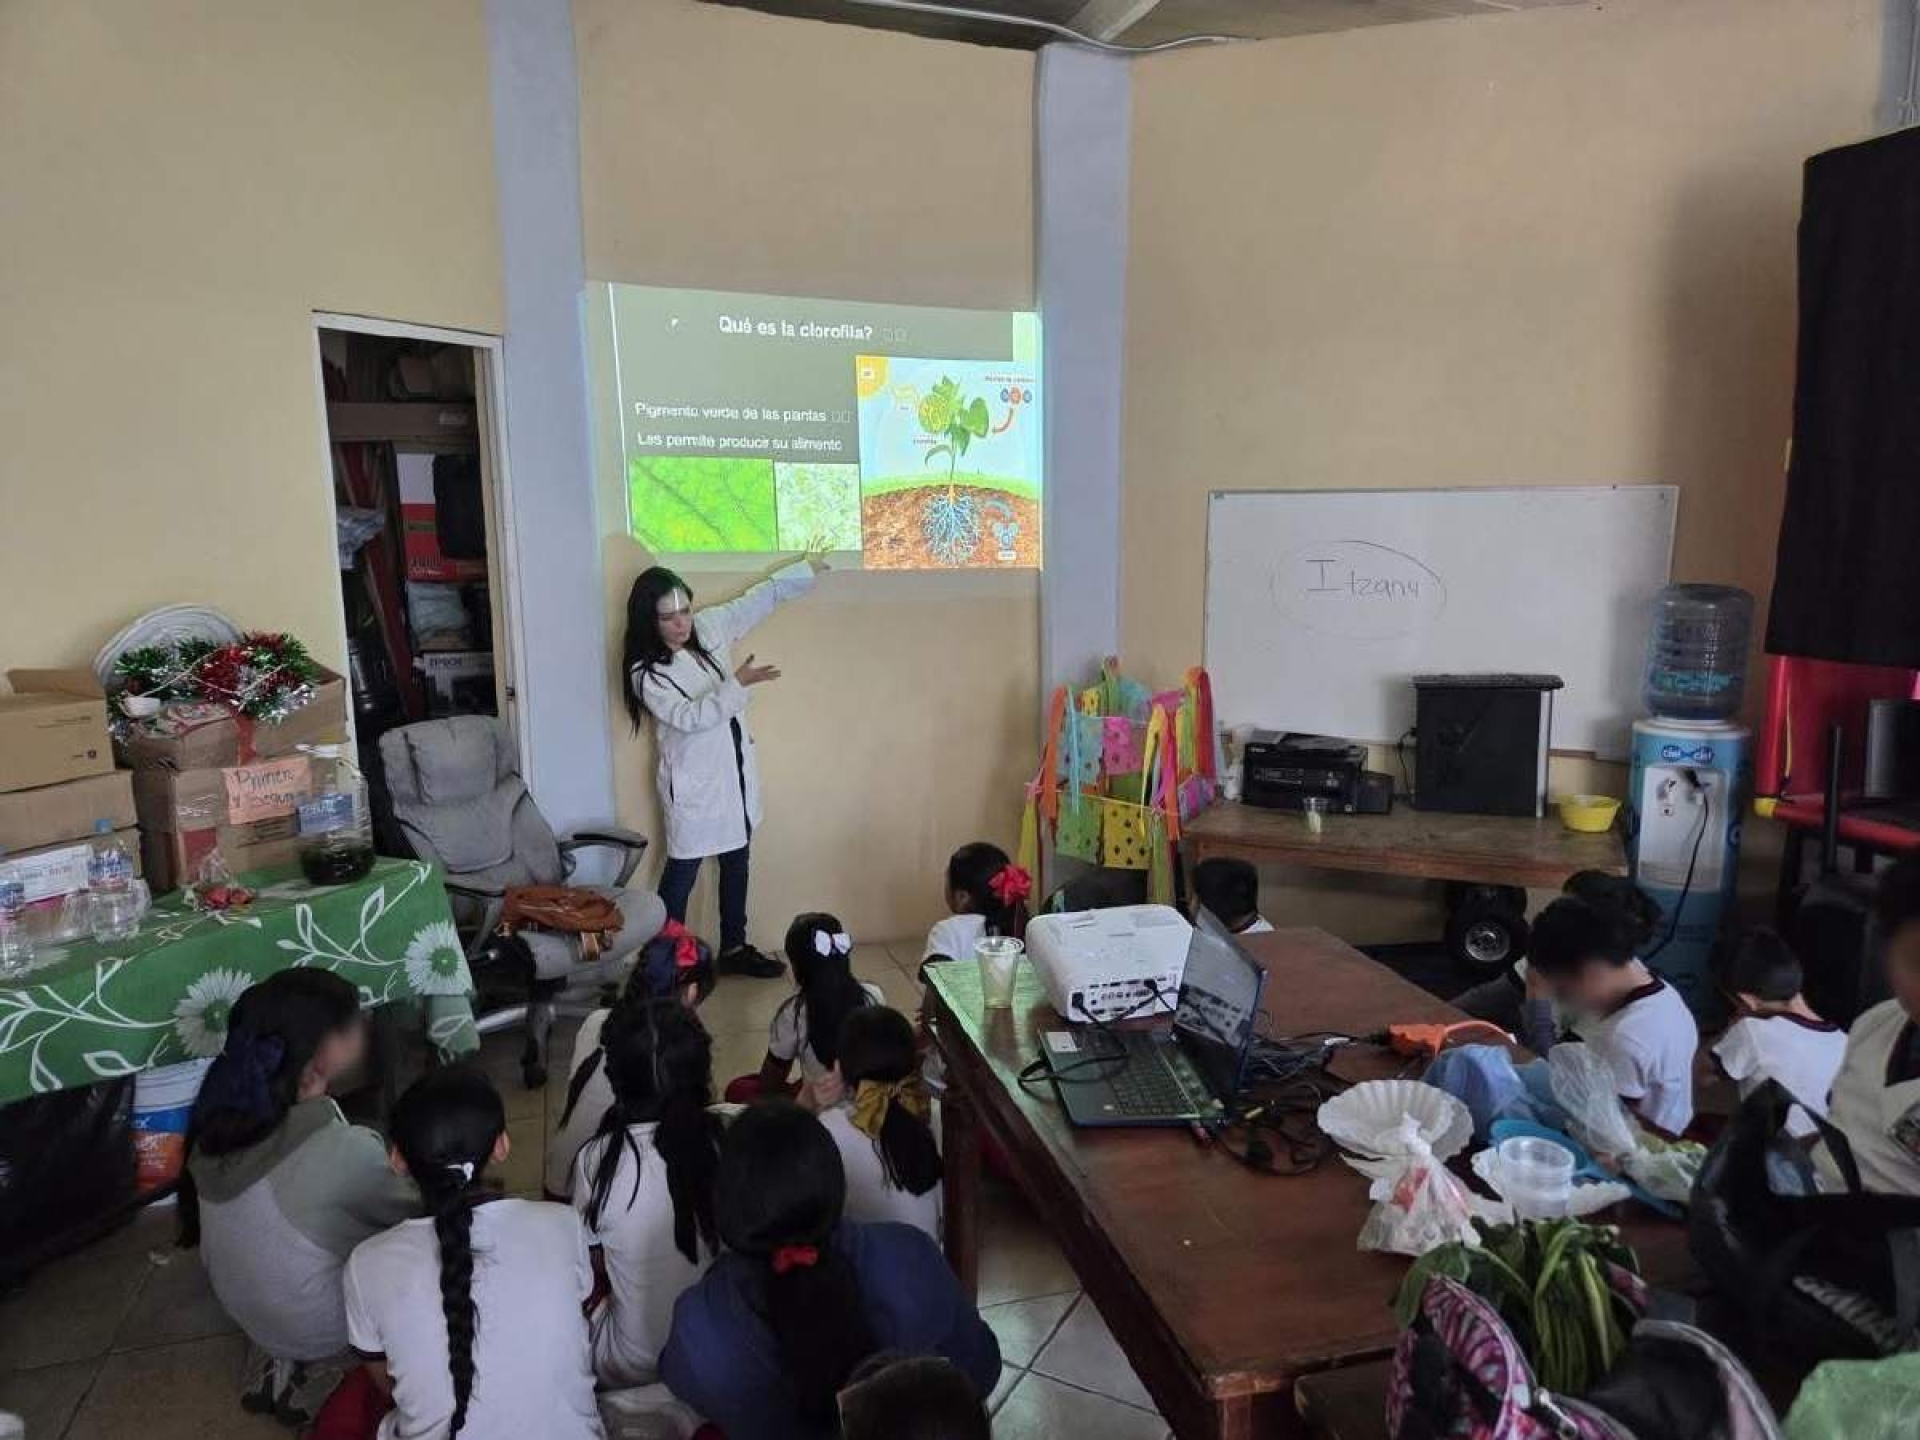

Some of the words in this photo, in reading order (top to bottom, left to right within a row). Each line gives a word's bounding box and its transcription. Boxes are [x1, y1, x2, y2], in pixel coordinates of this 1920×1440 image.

[718, 315, 752, 334] Qué
[757, 321, 777, 336] es
[781, 319, 796, 337] la
[799, 321, 873, 340] clorofila?
[634, 401, 699, 419] Pigmento
[762, 408, 781, 421] las
[783, 408, 827, 423] plantas
[772, 438, 788, 449] su
[791, 436, 843, 450] alimento
